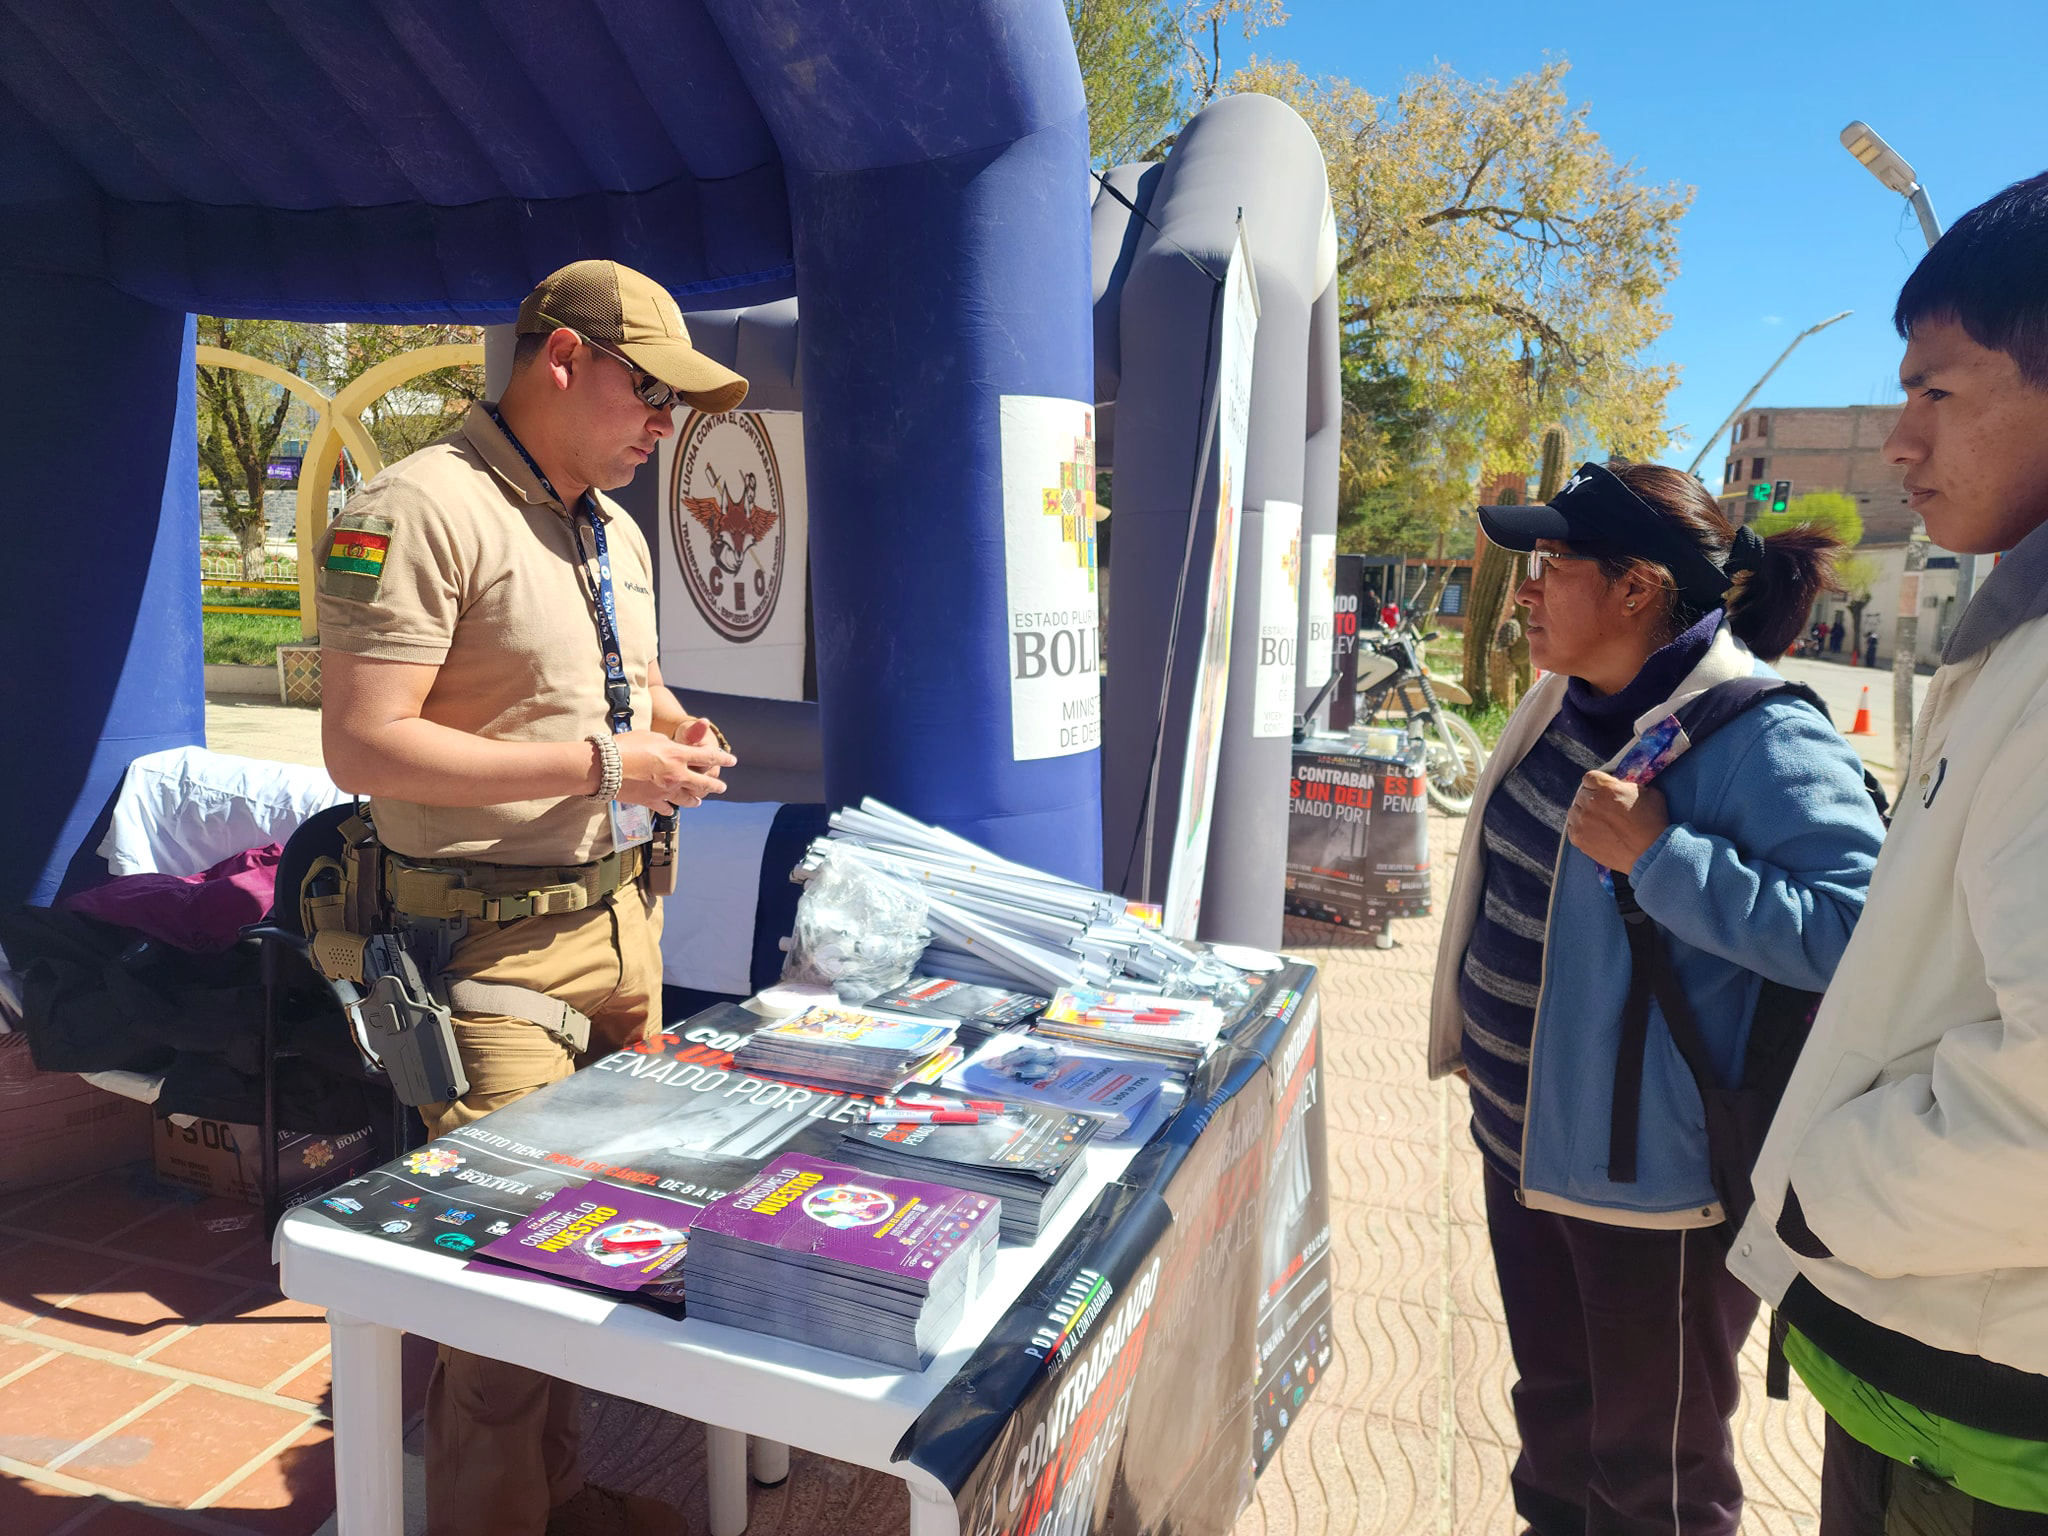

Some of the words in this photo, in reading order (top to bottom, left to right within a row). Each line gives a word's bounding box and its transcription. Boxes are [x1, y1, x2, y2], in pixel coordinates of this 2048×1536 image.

[683, 443, 700, 497] LUCHA
[696, 412, 728, 445] CONTRA
[728, 410, 738, 426] EL
[739, 415, 777, 510] CONTRABANDO
[1752, 483, 1772, 501] 12
[1015, 611, 1068, 628] ESTADO
[1060, 726, 1078, 748] DE
[1305, 781, 1331, 802] UN
[1334, 785, 1374, 809] DELI
[1384, 776, 1408, 797] ES
[1335, 805, 1363, 824] POR
[723, 1079, 812, 1112] POR
[454, 1170, 530, 1195] BOLIVIA
[463, 1127, 512, 1150] DELITO
[507, 1142, 550, 1159] TIENE
[544, 1152, 585, 1169] PENA
[587, 1161, 608, 1173] DE
[658, 1179, 682, 1191] DE
[680, 1184, 695, 1194] 8
[693, 1187, 708, 1198] A
[732, 1176, 789, 1210] CONSUME
[784, 1168, 800, 1181] LO
[751, 1172, 824, 1216] NUESTRO
[519, 1208, 578, 1247] CONSUME
[574, 1202, 598, 1217] LO
[535, 1205, 619, 1253] NUESTRO
[1024, 1327, 1060, 1360] POR
[1048, 1268, 1101, 1325] BOLIVIA
[1047, 1352, 1063, 1382] DILE
[1059, 1341, 1072, 1363] NO
[1069, 1331, 1080, 1351] AL
[1076, 1280, 1114, 1339] CONTRABANDO
[1007, 1256, 1161, 1514] CONTRABANDO
[1097, 1372, 1138, 1467] LEY
